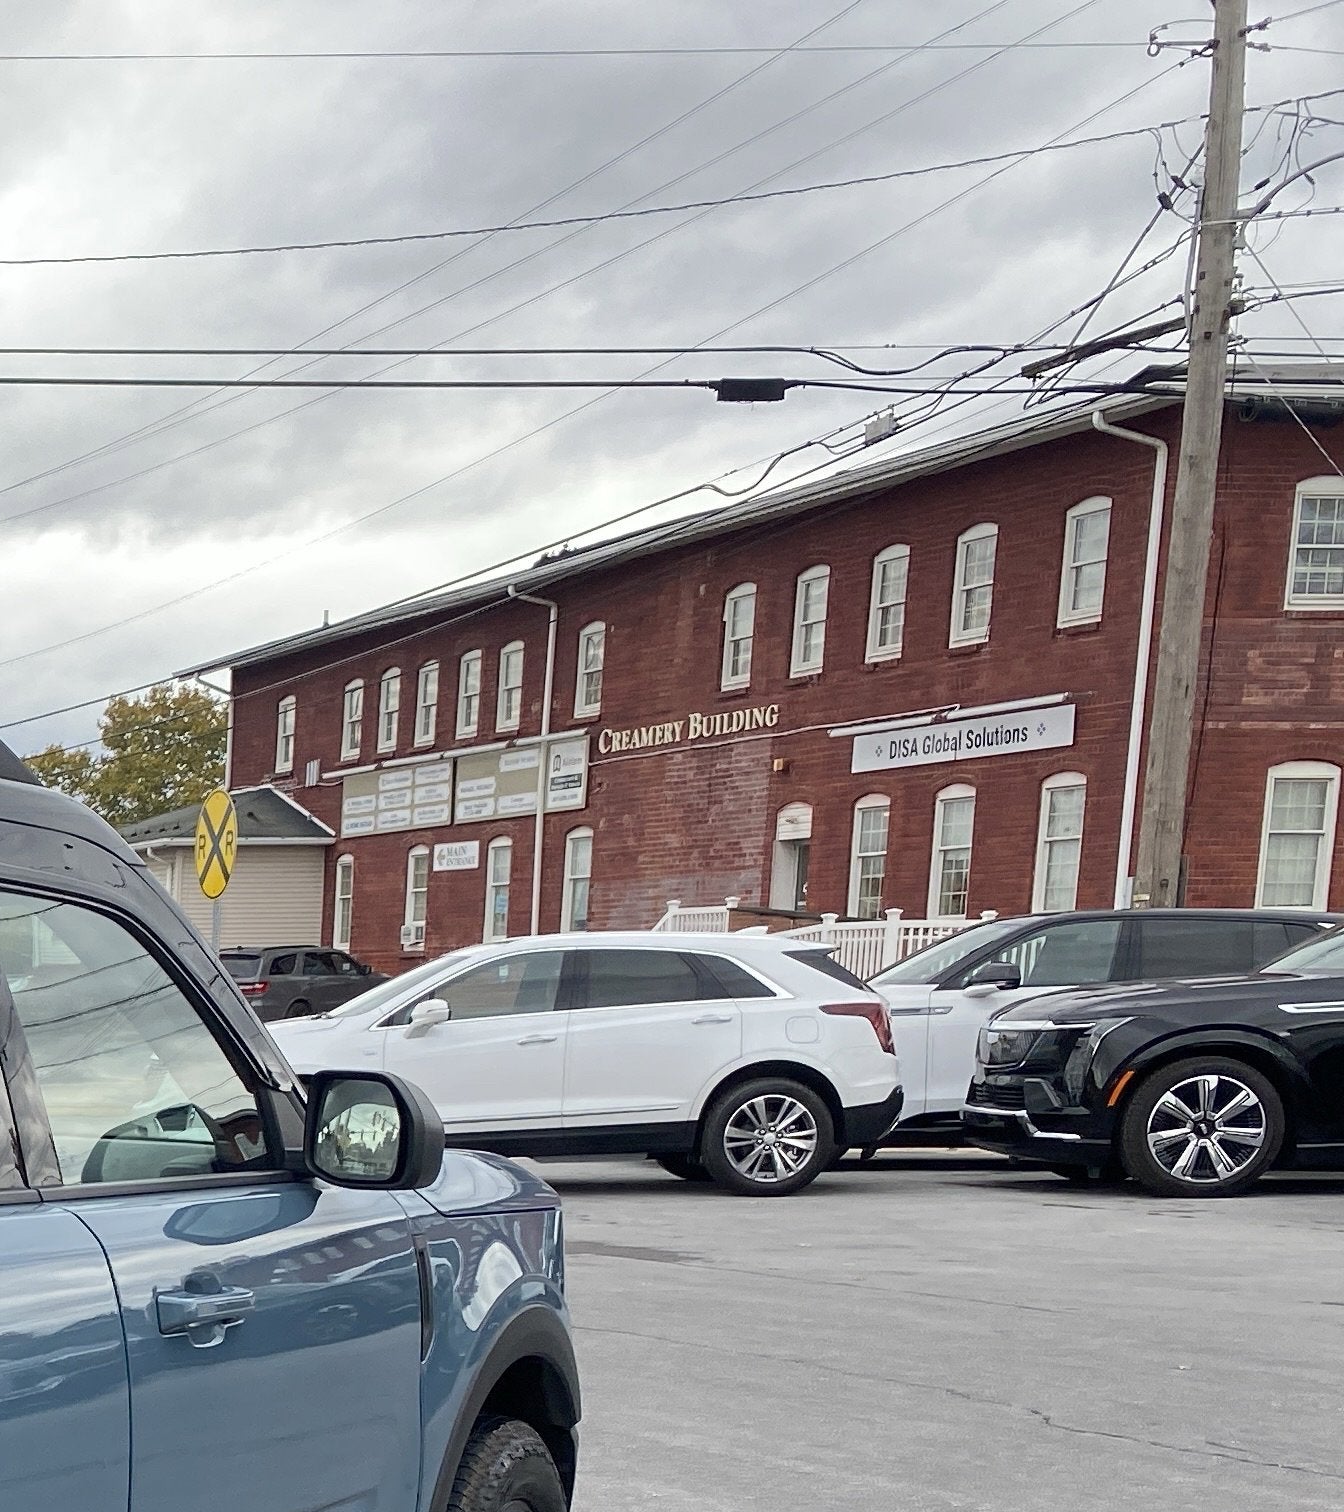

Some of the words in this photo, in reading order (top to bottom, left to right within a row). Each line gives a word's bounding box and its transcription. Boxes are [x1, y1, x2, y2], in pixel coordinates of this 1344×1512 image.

[889, 737, 918, 760] DISA
[923, 730, 962, 754] Global
[966, 725, 1028, 749] Solutions
[446, 845, 468, 857] MAIN
